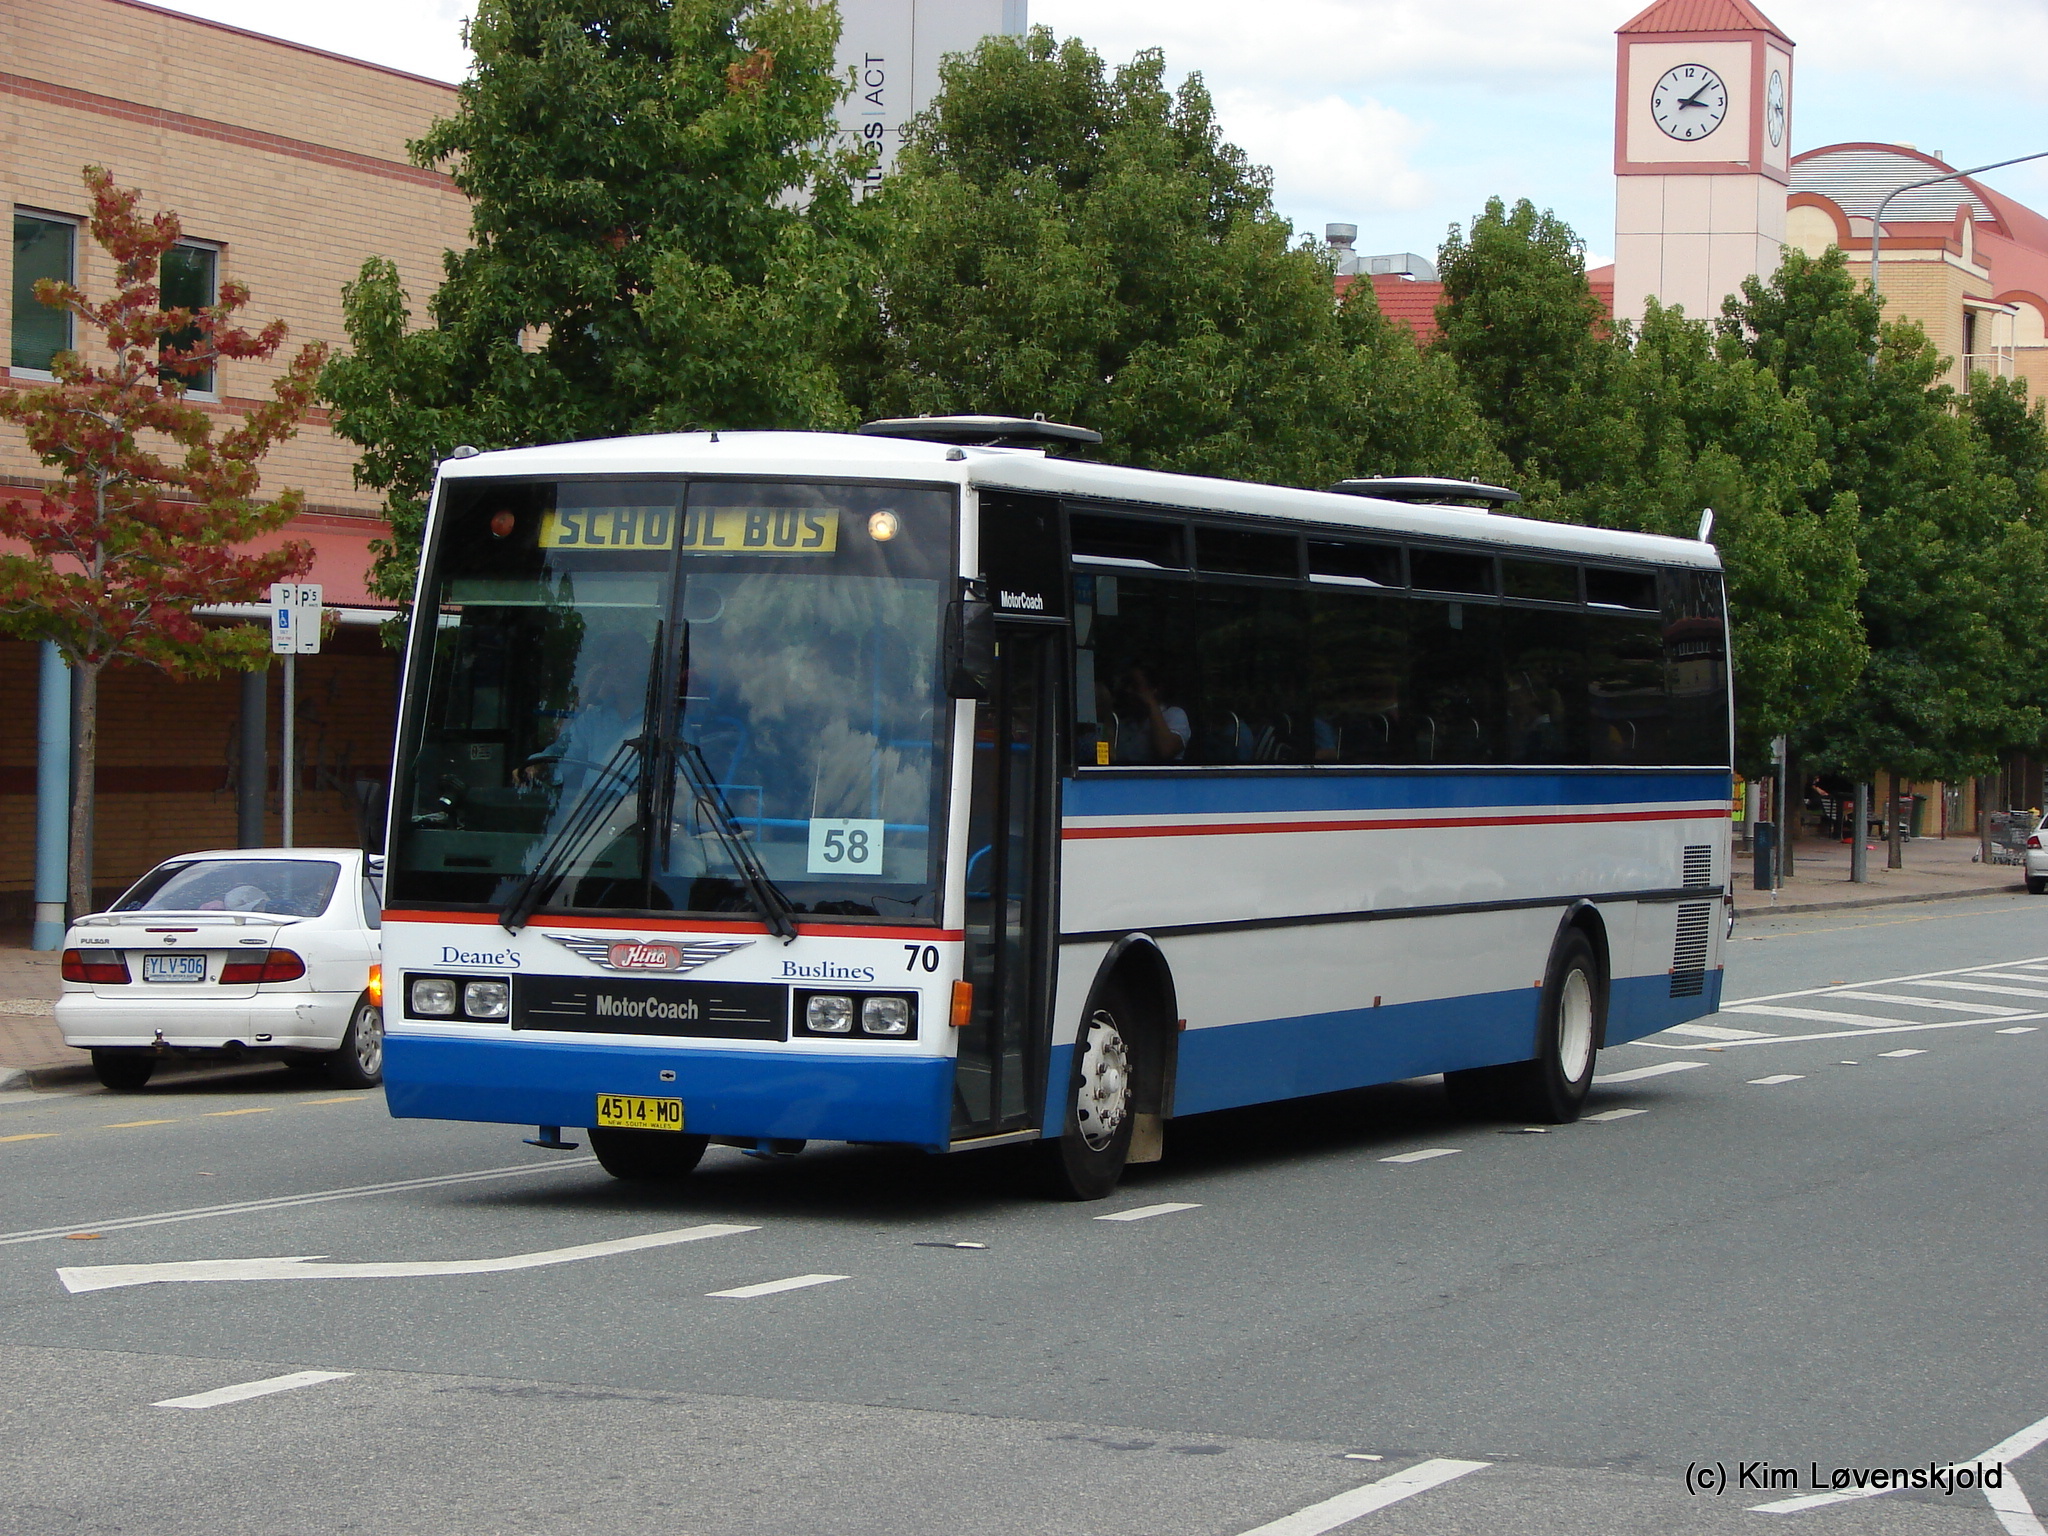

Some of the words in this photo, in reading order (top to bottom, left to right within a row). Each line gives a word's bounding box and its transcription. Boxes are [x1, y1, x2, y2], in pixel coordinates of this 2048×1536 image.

[865, 53, 884, 106] ACT
[1685, 68, 1694, 78] 12
[1655, 98, 1661, 108] 9
[1718, 97, 1724, 107] 3
[1685, 128, 1692, 137] 6
[558, 508, 726, 547] SCHOOL
[743, 508, 826, 548] BUS
[283, 590, 290, 604] P
[1001, 590, 1043, 610] MotorCoach
[823, 829, 869, 864] 58
[621, 944, 667, 968] Hino
[904, 944, 940, 973] 70
[596, 995, 699, 1020] MotorCoach
